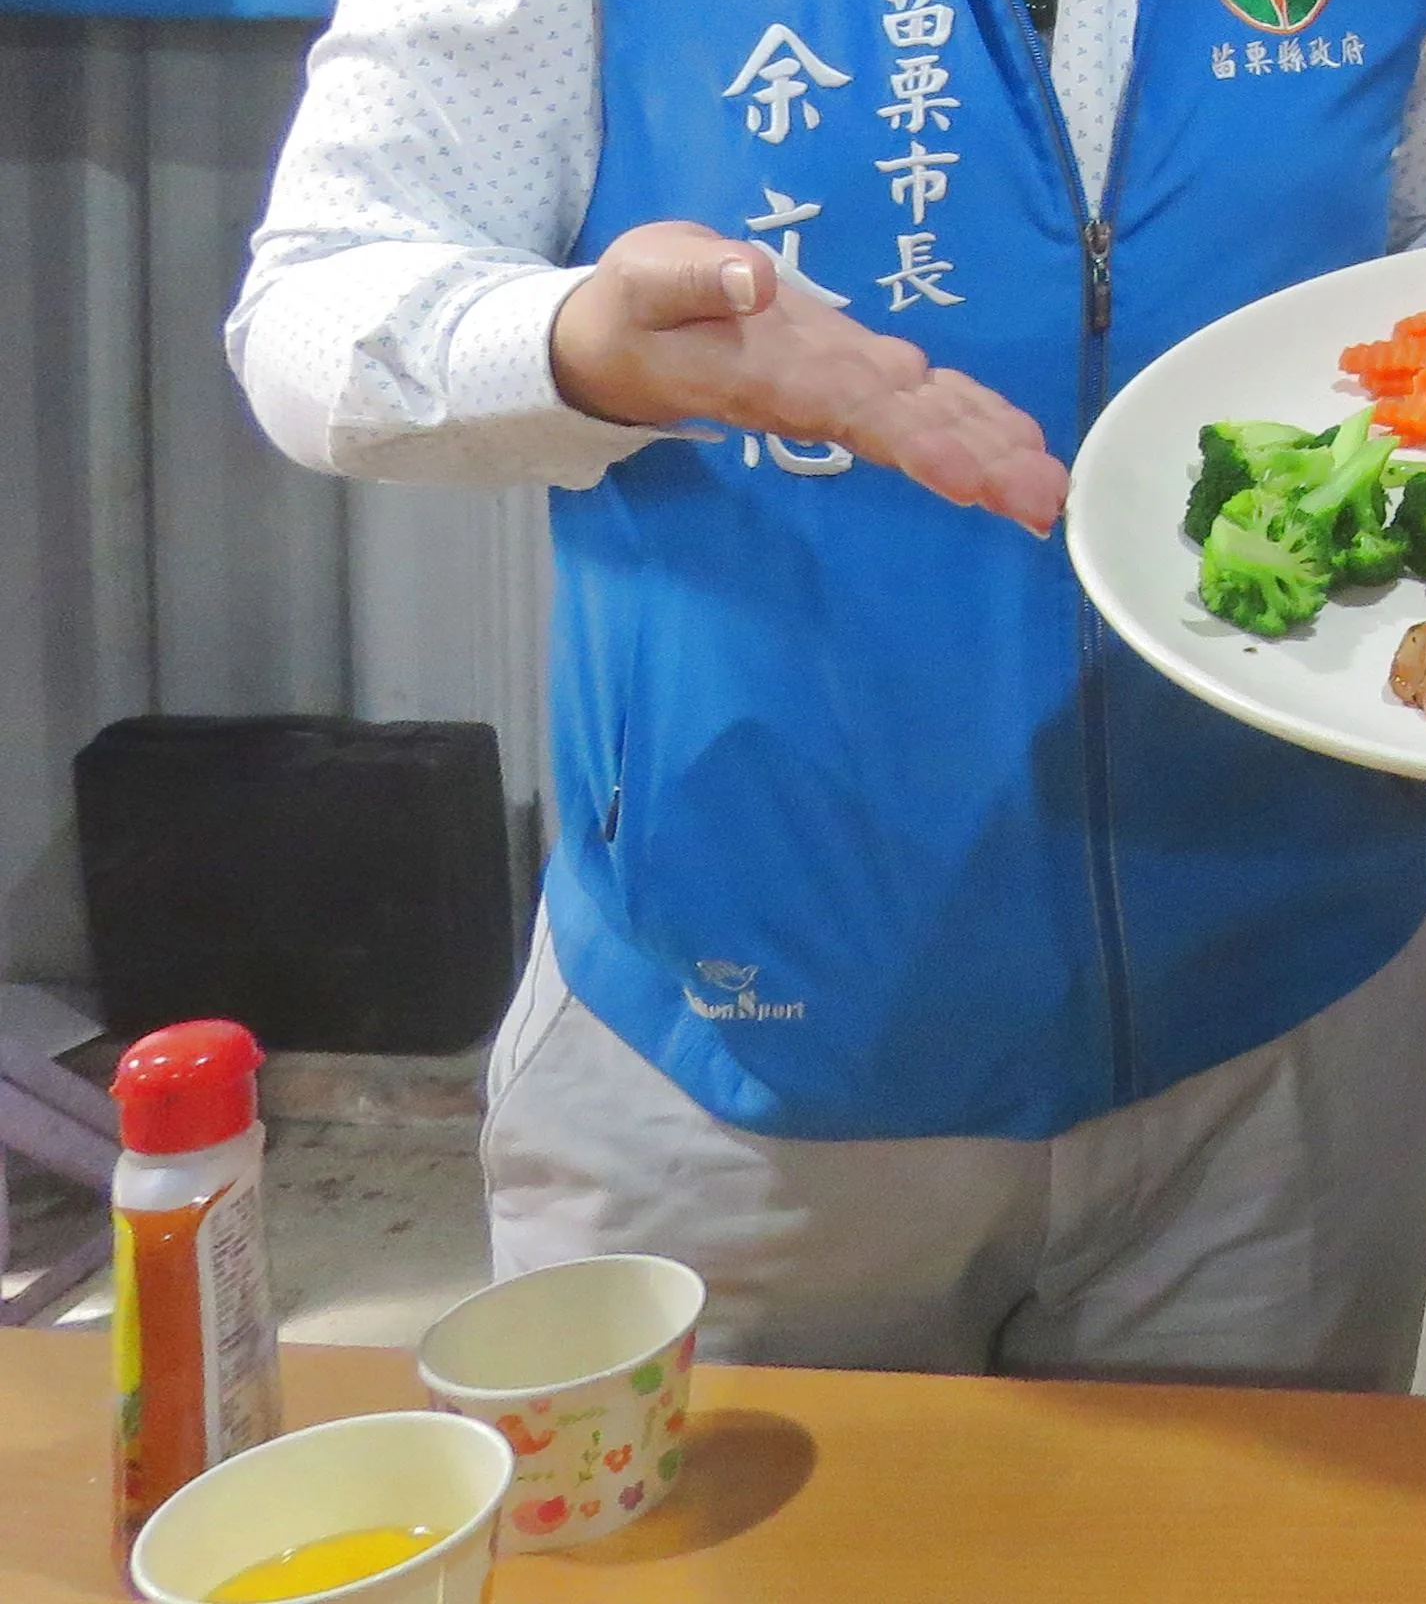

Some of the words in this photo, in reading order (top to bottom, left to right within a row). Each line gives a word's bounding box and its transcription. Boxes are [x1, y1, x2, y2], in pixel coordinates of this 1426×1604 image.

[1211, 31, 1366, 80] 苗栗縣政府
